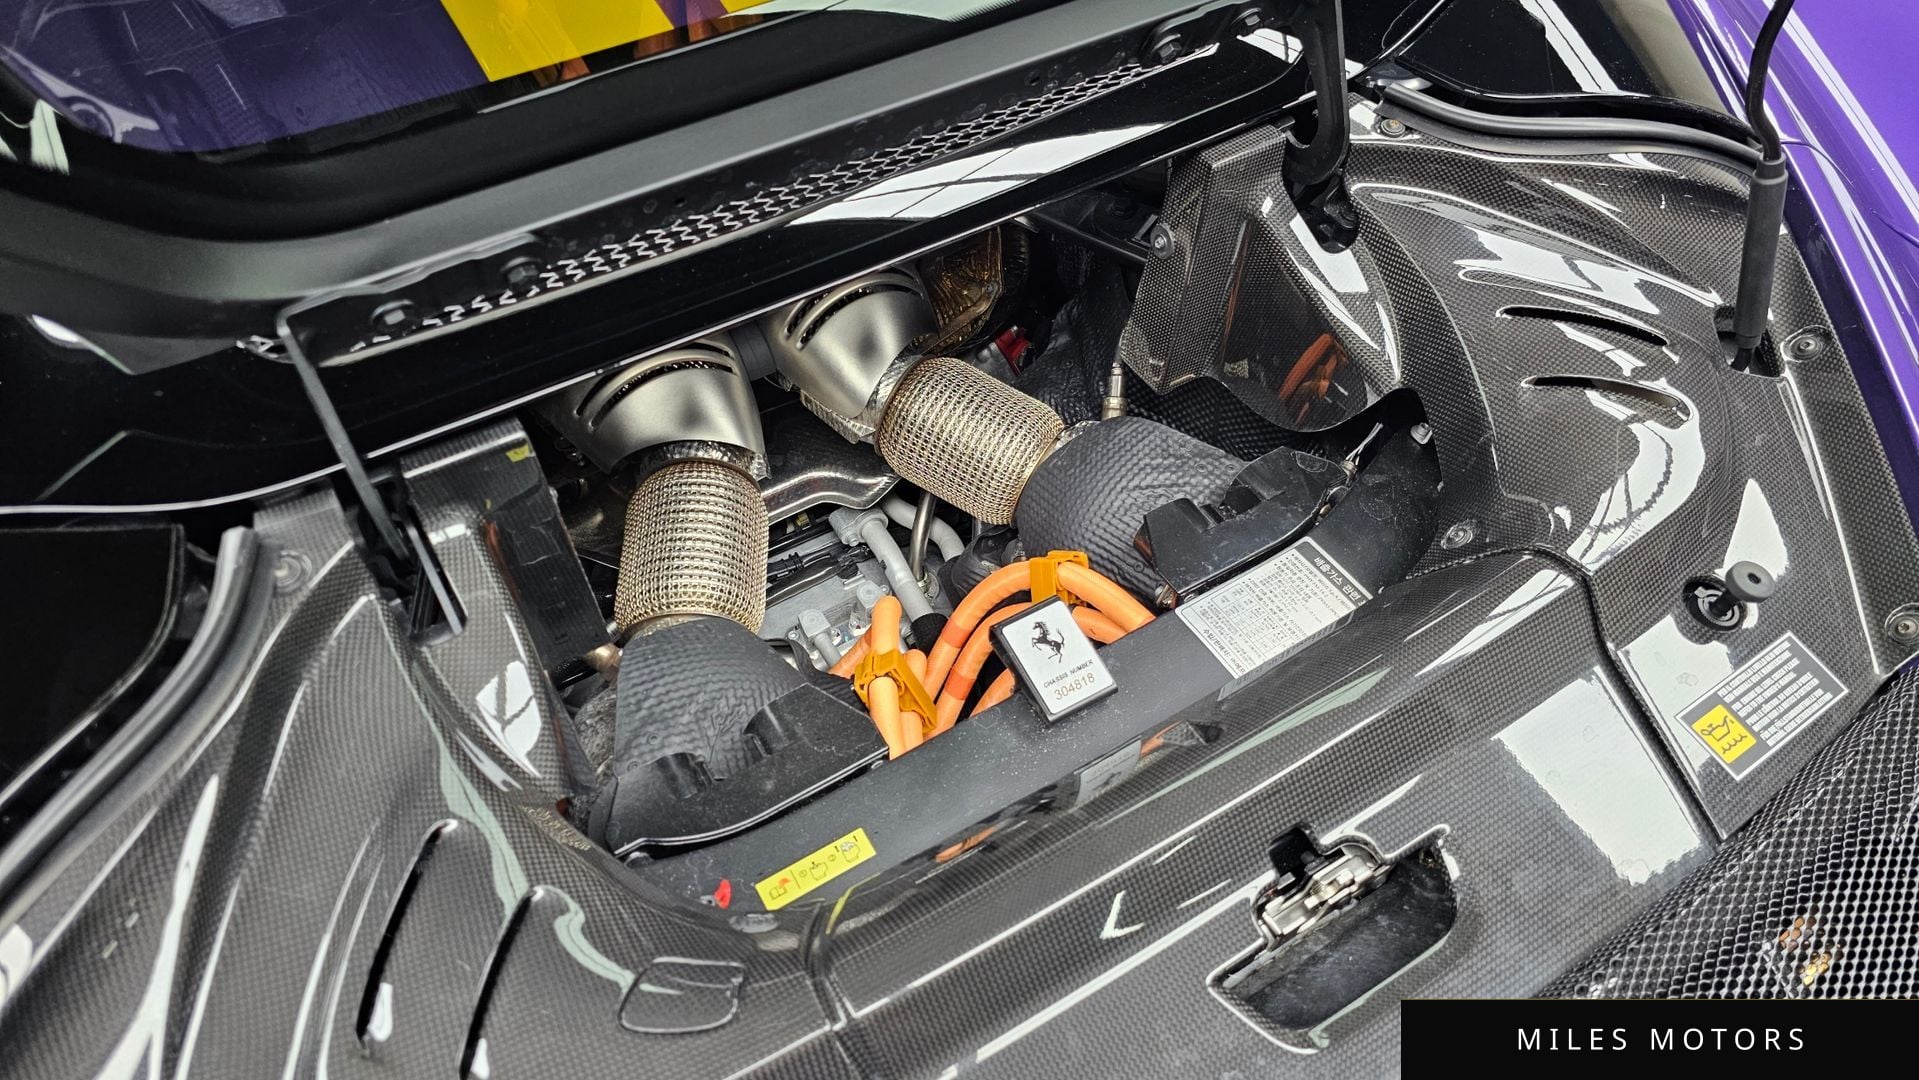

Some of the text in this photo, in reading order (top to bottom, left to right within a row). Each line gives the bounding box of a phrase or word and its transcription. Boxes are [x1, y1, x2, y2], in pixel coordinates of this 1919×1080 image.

[1313, 556, 1344, 586] 배출가스
[1341, 585, 1362, 602] 관련
[1043, 659, 1094, 688] CHASSIS NUMBER
[1054, 672, 1096, 701] 304818
